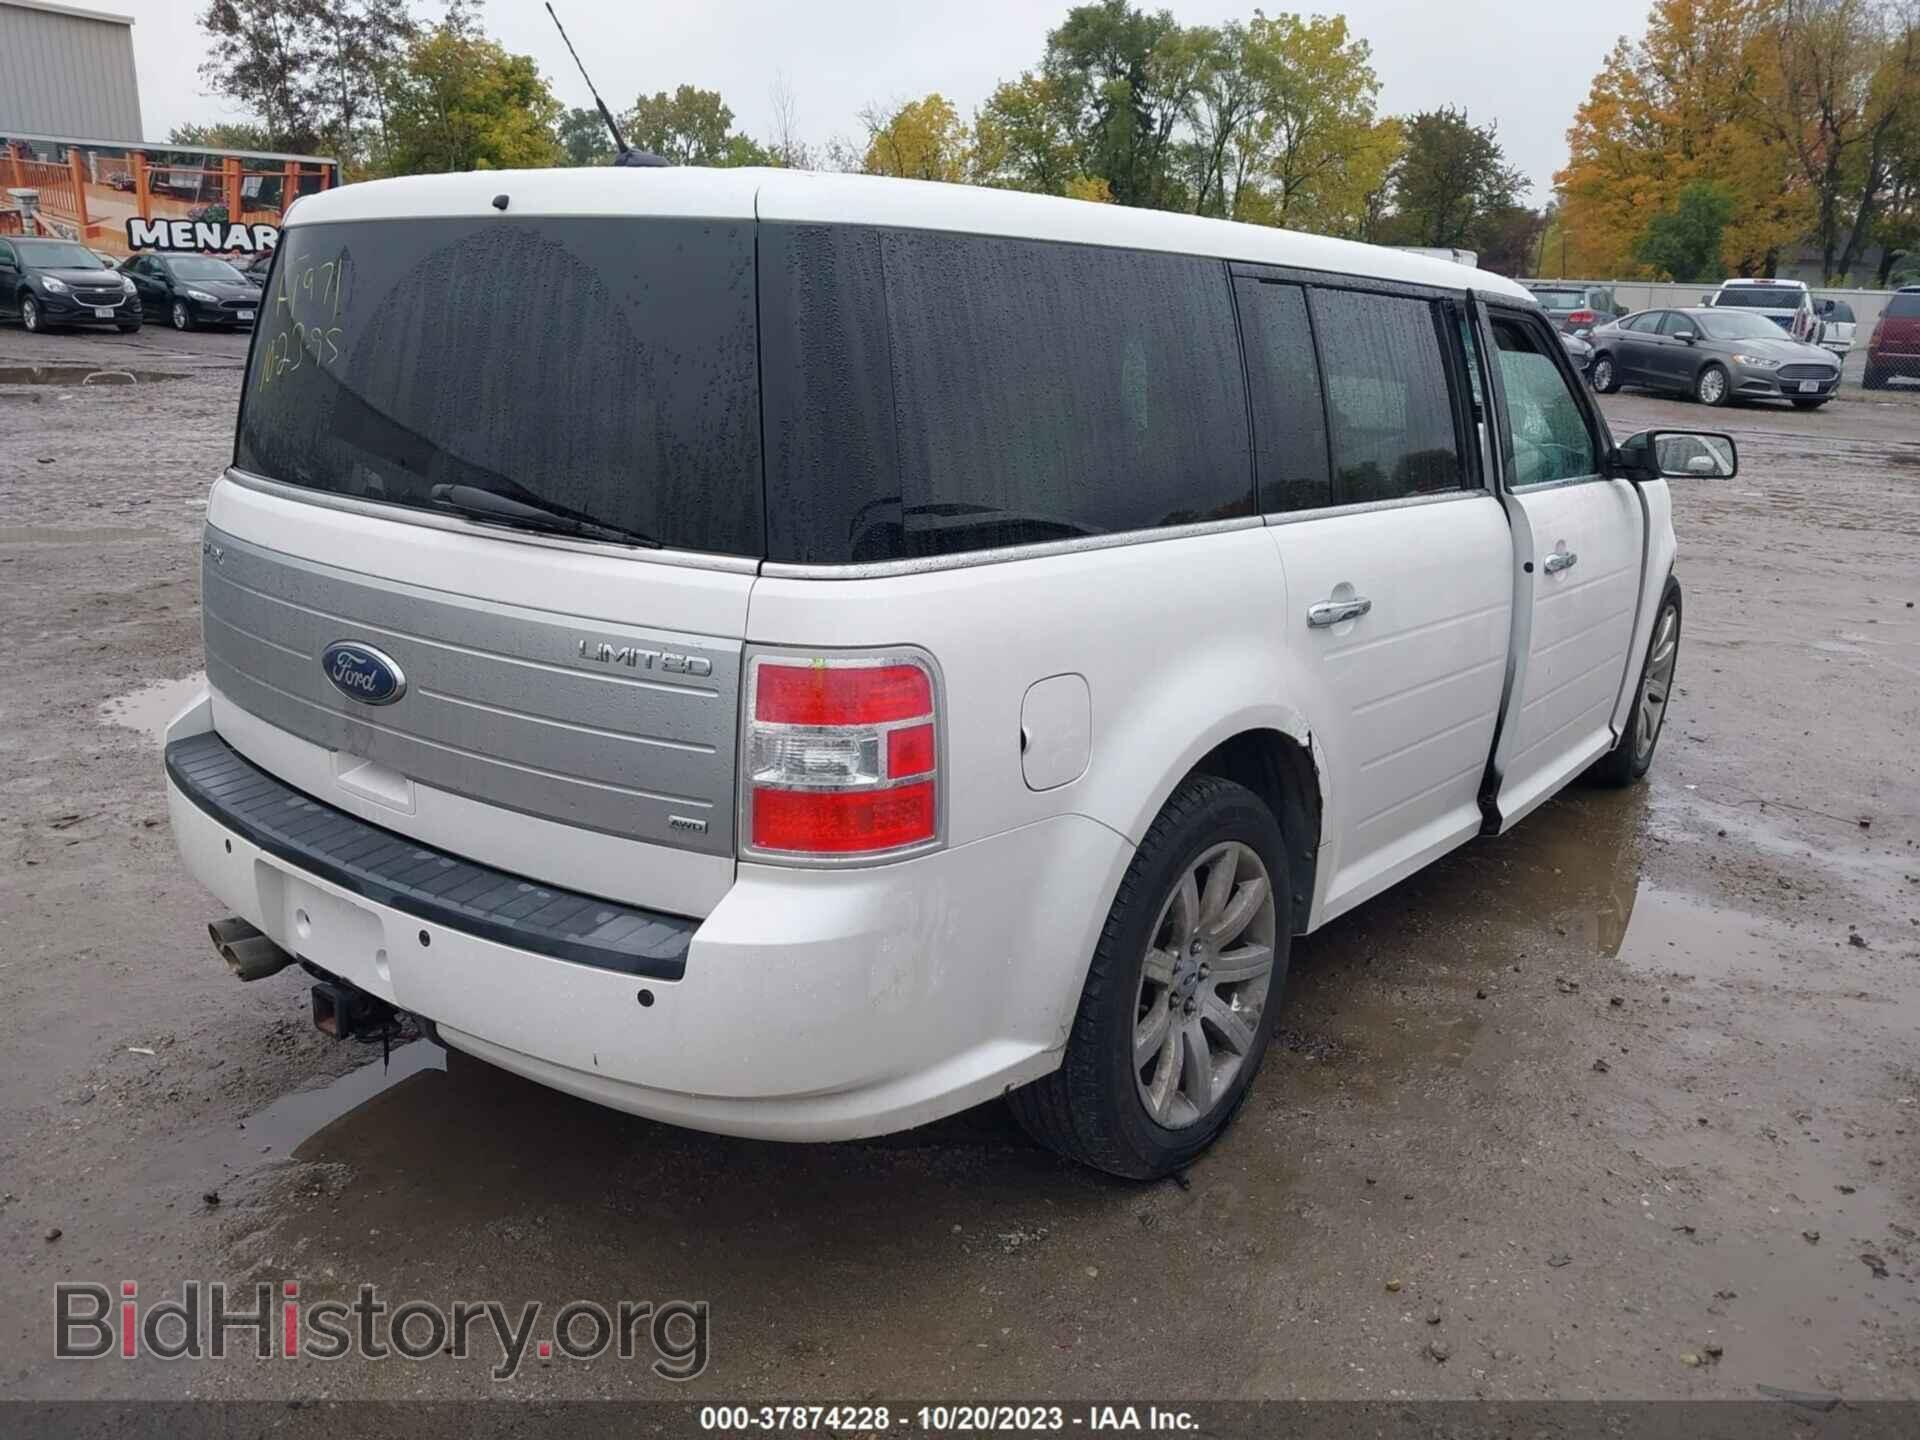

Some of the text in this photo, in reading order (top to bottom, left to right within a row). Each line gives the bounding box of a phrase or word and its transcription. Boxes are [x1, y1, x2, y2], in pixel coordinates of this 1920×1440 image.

[128, 218, 279, 252] MENAR
[332, 651, 378, 692] Ford
[579, 639, 713, 678] LIMITED
[670, 817, 706, 833] AWD
